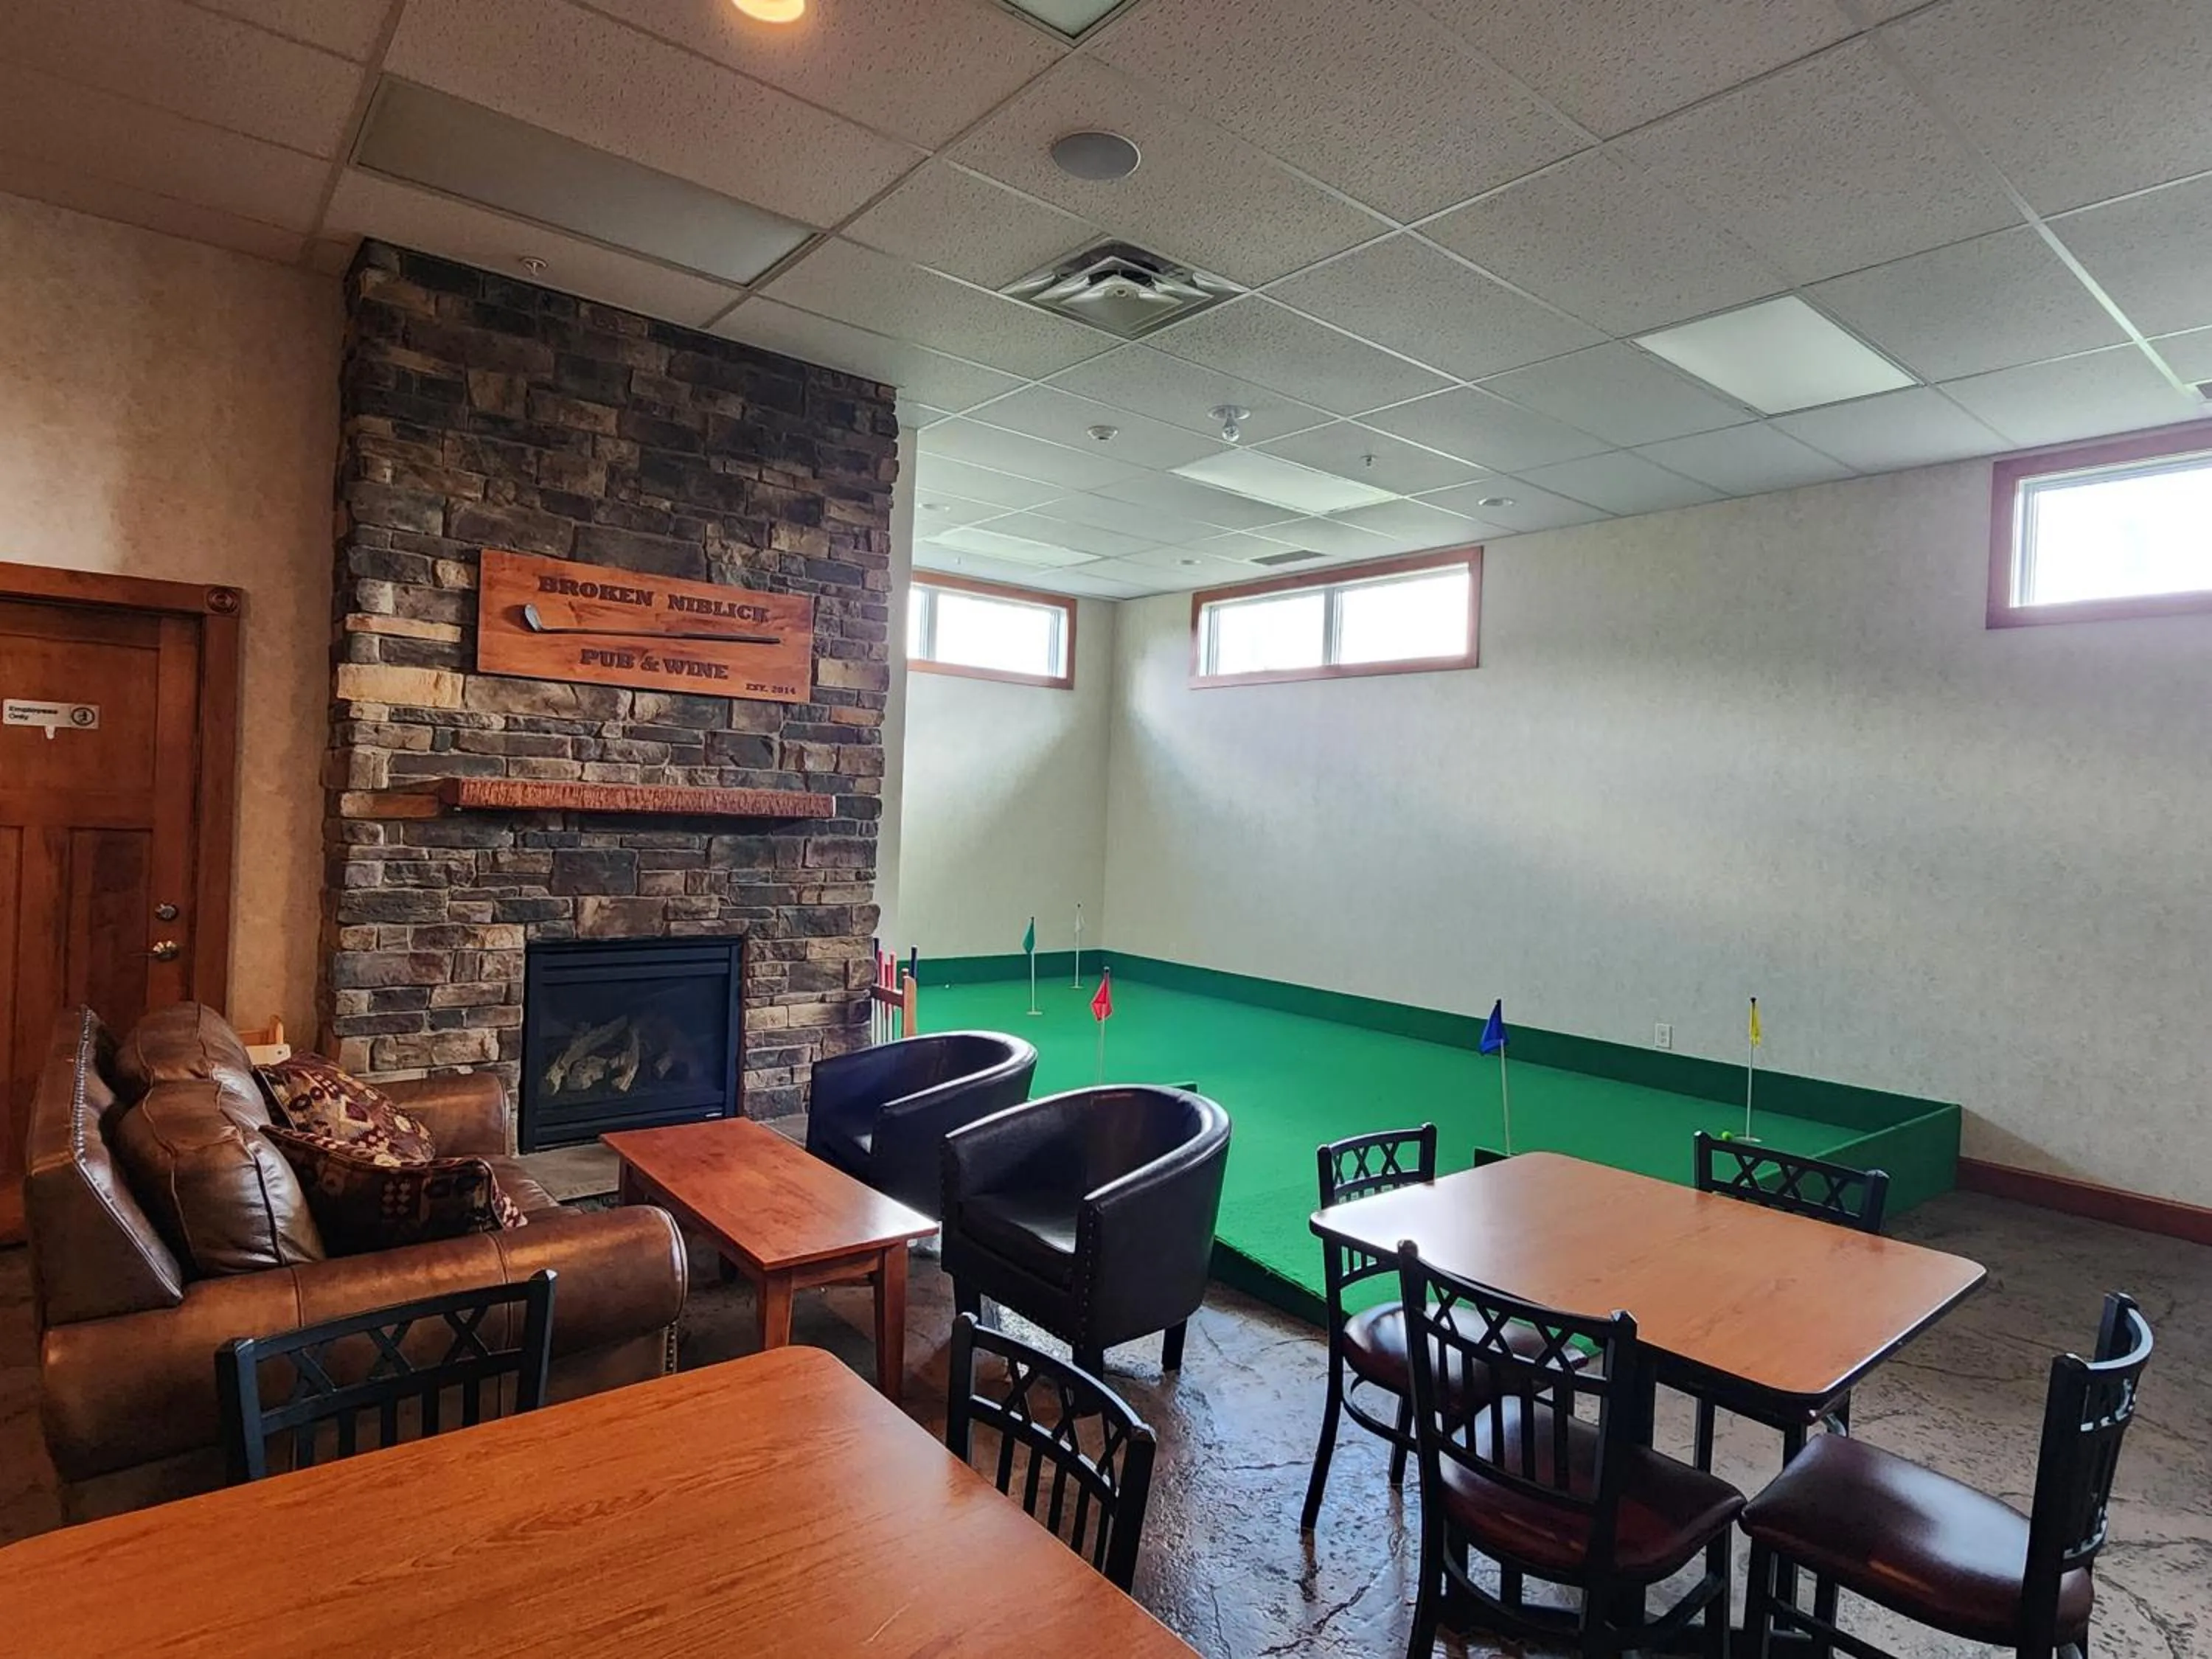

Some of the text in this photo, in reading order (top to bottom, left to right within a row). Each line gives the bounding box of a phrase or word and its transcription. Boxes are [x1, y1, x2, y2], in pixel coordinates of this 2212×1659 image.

[538, 576, 771, 624] BROKEN NIBLICK
[580, 648, 729, 680] PUB & WINE
[771, 685, 796, 695] 2014
